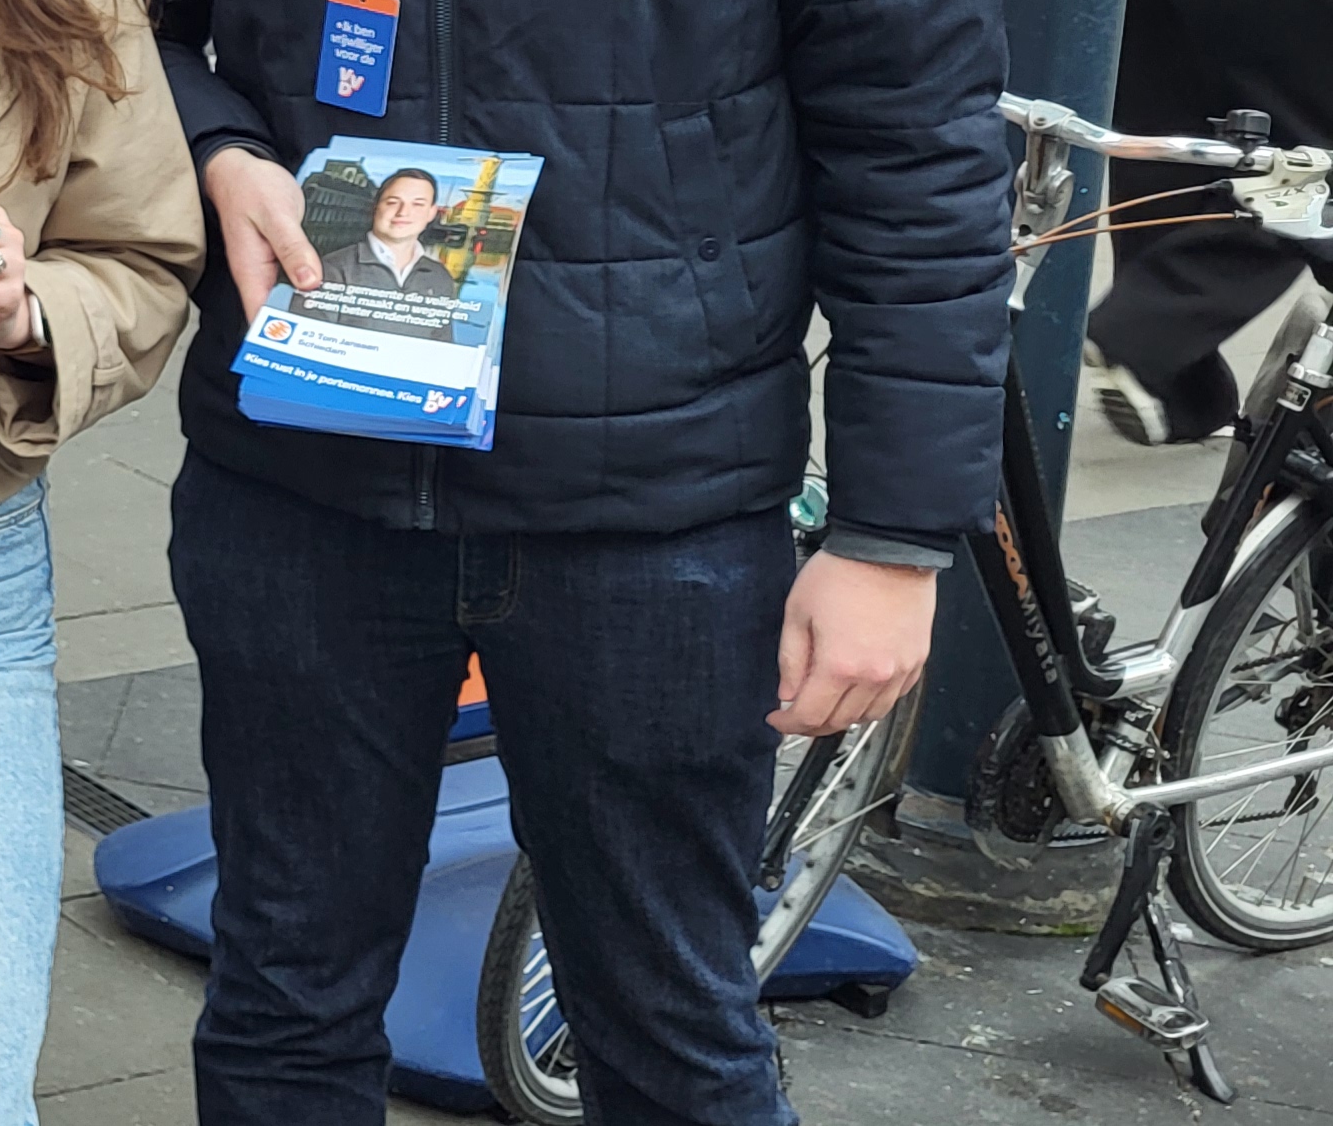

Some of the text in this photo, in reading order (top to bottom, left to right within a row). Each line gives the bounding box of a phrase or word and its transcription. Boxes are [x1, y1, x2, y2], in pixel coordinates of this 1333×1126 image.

[244, 353, 270, 368] Kies
[270, 362, 293, 375] rust
[294, 367, 306, 378] in
[305, 370, 318, 382] je
[396, 390, 422, 404] Kies
